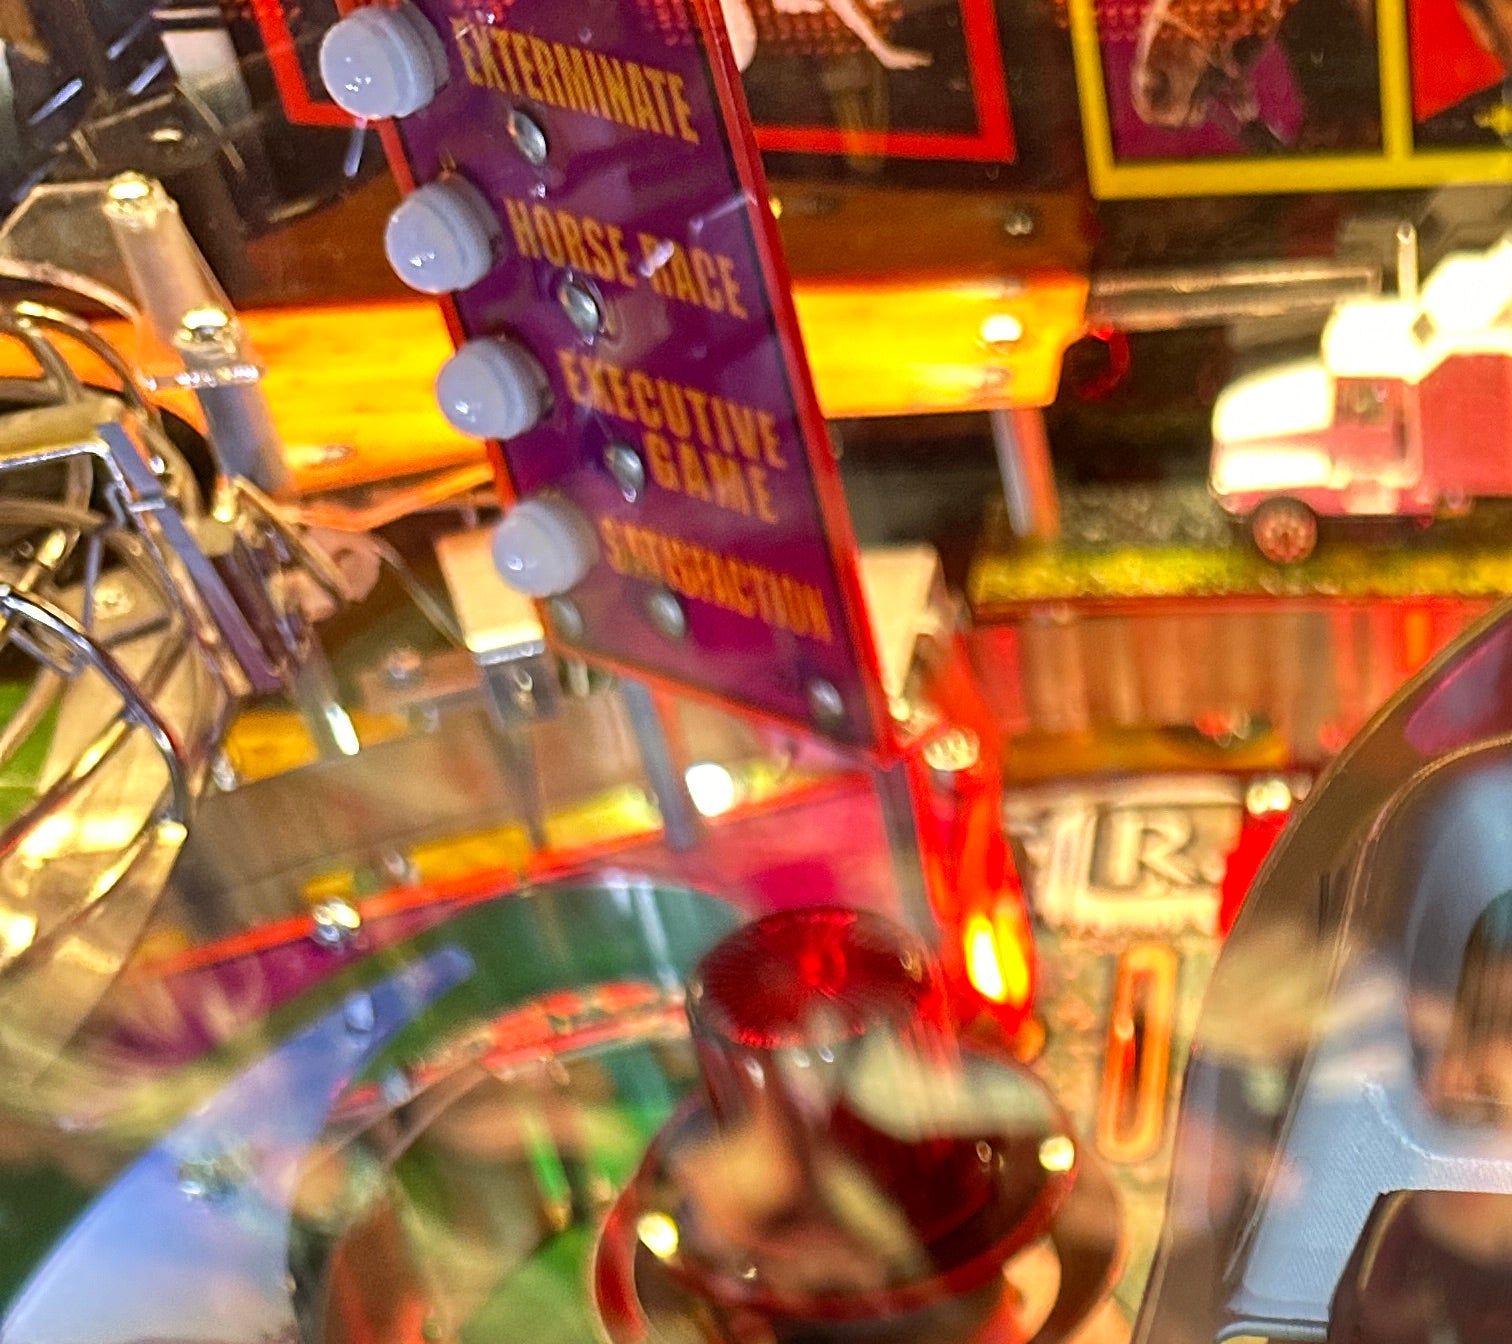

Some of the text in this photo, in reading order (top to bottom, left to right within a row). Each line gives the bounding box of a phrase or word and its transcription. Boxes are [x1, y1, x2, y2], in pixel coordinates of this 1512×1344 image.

[451, 18, 699, 145] EXTERMINATE
[504, 197, 748, 320] HORSE RACE
[558, 348, 787, 470] EXECUTIVE
[643, 431, 778, 524] GAME
